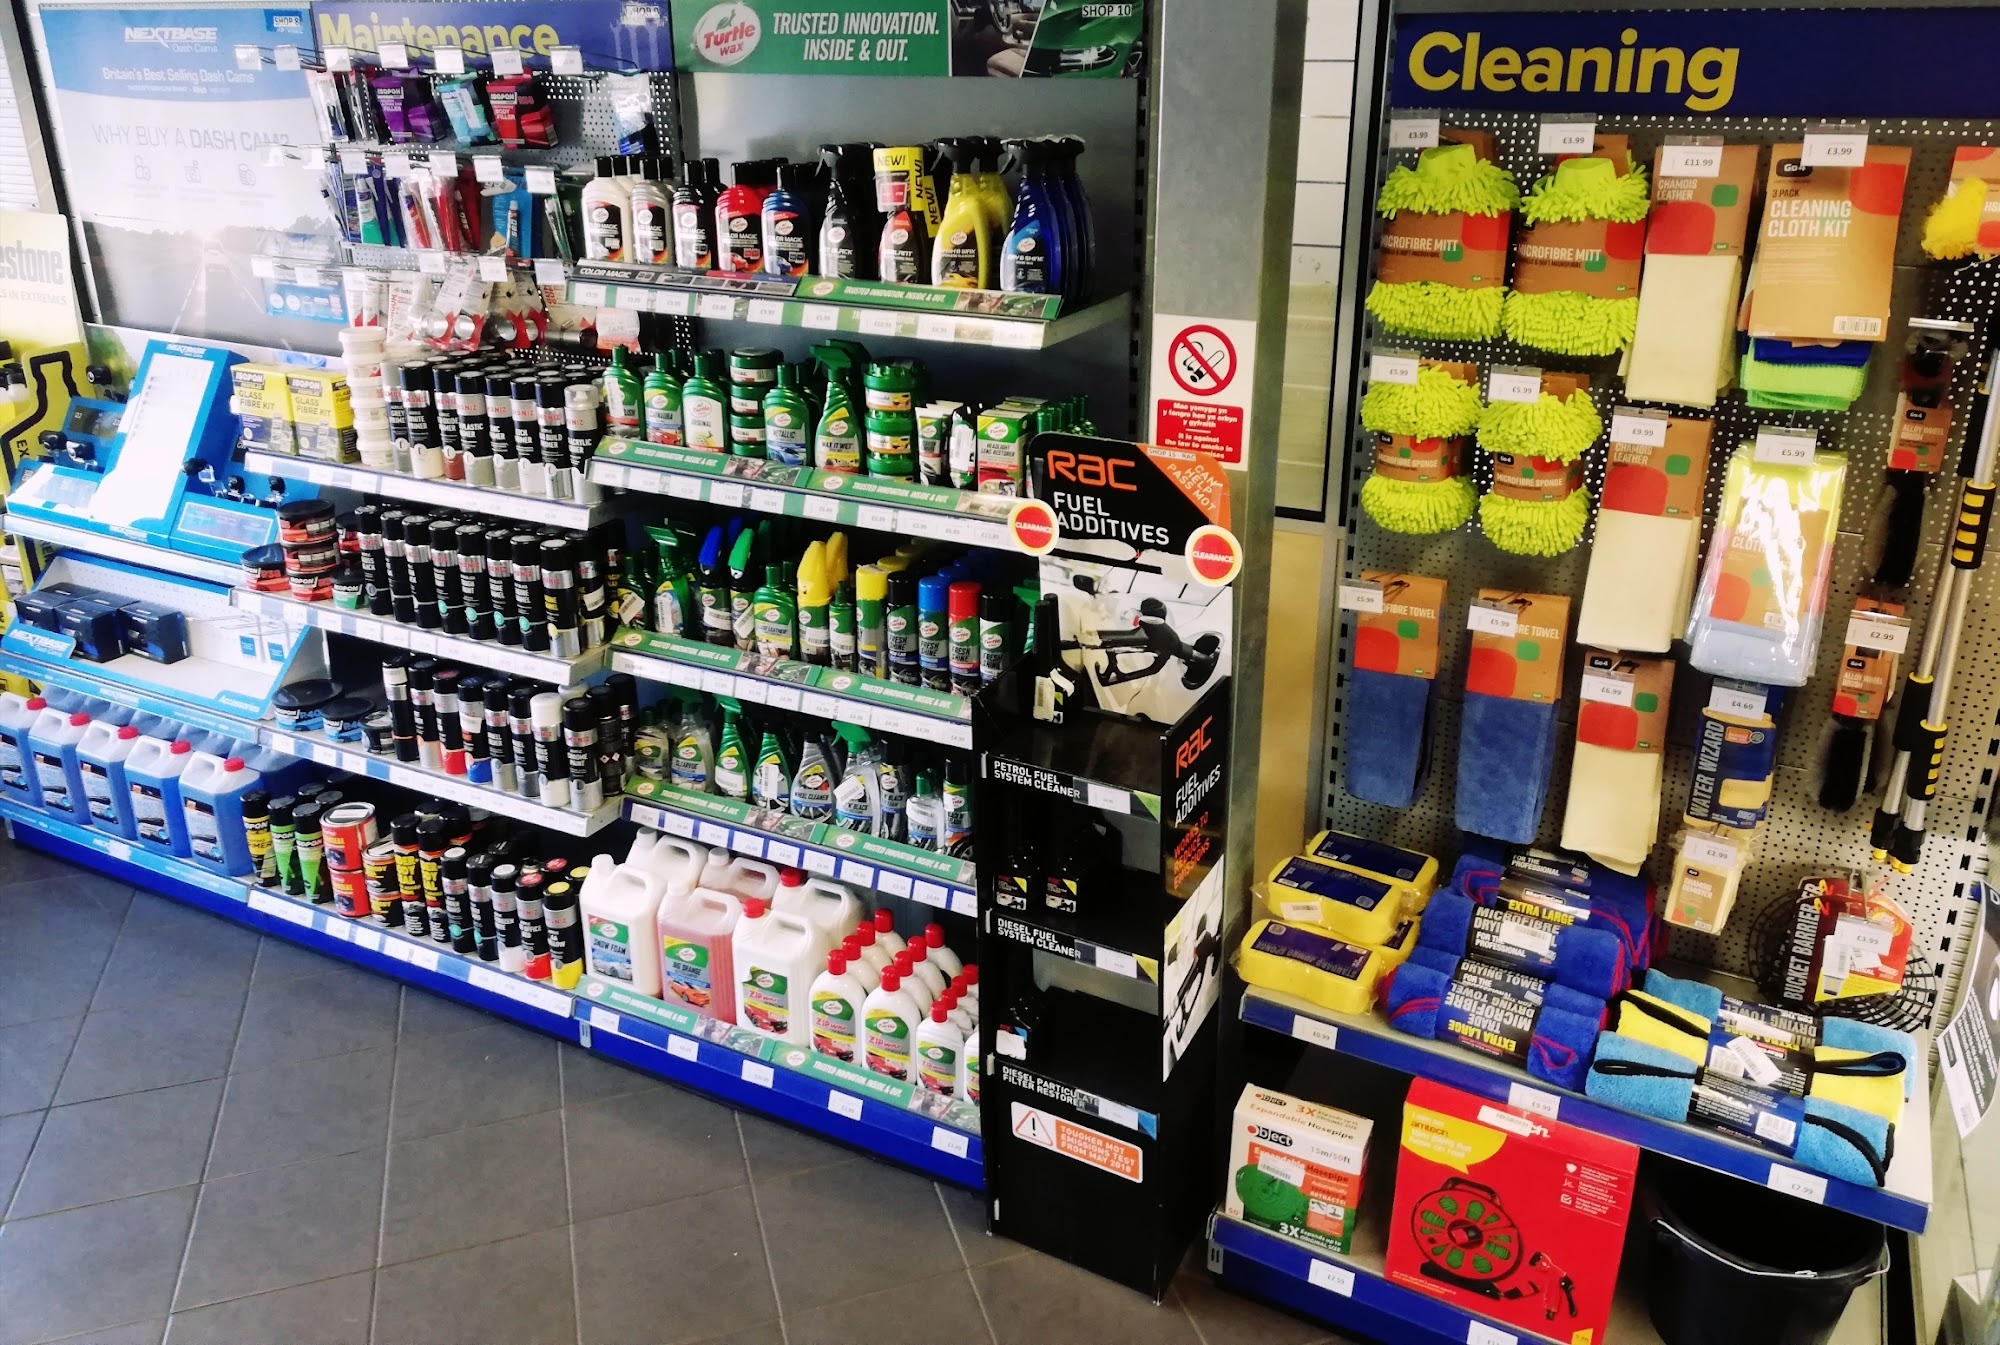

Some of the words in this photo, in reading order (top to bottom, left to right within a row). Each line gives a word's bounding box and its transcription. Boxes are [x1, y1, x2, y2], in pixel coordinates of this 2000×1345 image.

[1082, 5, 1117, 17] SHOP
[1119, 5, 1132, 17] 10
[772, 12, 840, 35] TRUSTED
[843, 12, 940, 36] INNOVATION.
[125, 27, 217, 47] NEXTBASE
[319, 13, 560, 58] Maintenance
[704, 22, 756, 49] Turtle
[720, 42, 744, 56] wax
[803, 38, 855, 61] INSIDE
[859, 39, 871, 61] &
[874, 39, 909, 62] OUT.
[102, 67, 142, 81] Britain's
[144, 68, 165, 80] Best
[168, 69, 199, 84] Selling
[200, 69, 224, 82] Dash
[226, 70, 255, 83] Cams
[1408, 28, 1740, 111] Cleaning
[92, 125, 131, 145] WHY
[136, 126, 169, 146] BUY
[175, 128, 187, 147] A
[189, 129, 235, 150] DASH
[1408, 131, 1428, 139] £3.99
[1562, 136, 1585, 144] £3.99
[877, 155, 906, 166] NEW!
[1827, 147, 1852, 155] £3.99
[1684, 158, 1714, 167] £11.99
[1658, 178, 1698, 190] CHAMOIS
[1772, 189, 1778, 198] 3
[1779, 189, 1800, 198] PACK
[1657, 190, 1694, 201] LEATHER
[1770, 200, 1852, 219] CLEANING
[1768, 219, 1822, 238] CLOTH
[1824, 220, 1852, 238] KIT
[1434, 239, 1459, 251] MITT
[1519, 243, 1574, 261] MICROFIBRE
[1575, 249, 1602, 262] MITT
[580, 267, 605, 277] COLOR
[605, 270, 632, 279] MAGIC
[235, 372, 264, 384] ISOPON
[1389, 368, 1409, 376] £5.99
[292, 378, 321, 390] ISOPON
[1512, 386, 1532, 394] £5.99
[238, 391, 263, 401] GLASS
[240, 400, 262, 410] FIBRE
[263, 402, 275, 411] KIT
[295, 396, 319, 407] GLASS
[297, 405, 319, 415] FIBRE
[320, 408, 331, 417] KIT
[1632, 428, 1654, 437] £9.99
[1614, 443, 1653, 455] CHAMOIS
[1781, 449, 1805, 458] £5.99
[1613, 453, 1649, 465] LEATHER
[1167, 463, 1194, 494] PASS
[1193, 487, 1217, 512] MOT
[1185, 467, 1214, 494] HELP
[1054, 491, 1110, 517] FUEL
[1015, 521, 1054, 535] CLEARANCE
[1057, 511, 1170, 546] ADDITIVES
[1192, 549, 1234, 564] CLEARANCE
[1490, 619, 1510, 627] £5.99
[1531, 625, 1560, 640] TOWEL
[1870, 631, 1894, 641] £2.99
[1601, 687, 1622, 696] £6.99
[1731, 701, 1753, 710] £4.69
[1698, 720, 1725, 774] WIZARD
[994, 761, 1032, 777] PETROL
[1034, 771, 1060, 785] FUEL
[994, 770, 1032, 787] SYSTEM
[1034, 779, 1081, 799] CLEANER
[1175, 772, 1200, 809] FUEL
[1174, 764, 1221, 829] ADDITIVES
[1690, 776, 1715, 818] WATER
[1174, 821, 1200, 858] WORKS
[1200, 811, 1209, 829] TO
[1174, 835, 1201, 876] REDUCE
[1174, 838, 1211, 891] EMISSIONS
[1706, 850, 1728, 860] £2.99
[1511, 860, 1561, 876] PROFESSIONAL
[1476, 906, 1561, 935] MICROFIBRE
[1508, 898, 1540, 917] EXTRA
[1542, 909, 1575, 926] LARGE
[998, 918, 1031, 935] DIESEL
[1033, 929, 1059, 944] FUEL
[1476, 931, 1491, 941] FOR
[1792, 902, 1821, 956] BARRIER
[593, 938, 610, 952] SNOW
[610, 943, 627, 956] FOAM
[997, 927, 1034, 946] SYSTEM
[1036, 936, 1082, 960] CLEANER
[1475, 939, 1527, 958] PROFESSIONAL
[1460, 961, 1503, 981] DRYING
[1505, 973, 1546, 993] TOWEL
[1463, 973, 1478, 984] FOR
[1479, 976, 1493, 988] THE
[1784, 957, 1810, 1000] BUCKET
[1451, 982, 1489, 1002] TOWEL
[1444, 991, 1533, 1032] MICROFIBRE
[1491, 996, 1536, 1019] DRYING
[1448, 1019, 1482, 1040] LARGE
[1467, 1013, 1501, 1034] TRADE
[1770, 1013, 1818, 1038] DRYING
[1483, 1029, 1517, 1053] EXTRA
[1002, 1065, 1035, 1084] DIESEL
[1002, 1074, 1035, 1091] FILTER
[1036, 1083, 1085, 1109] RESTORER
[1296, 1105, 1317, 1117] 3X
[1250, 1104, 1306, 1125] Expandable
[1308, 1121, 1354, 1140] Hosepipe
[1410, 1120, 1449, 1137] amtech
[1060, 1125, 1106, 1148] TOUGHER
[1108, 1141, 1125, 1155] MOT
[1061, 1133, 1112, 1158] EMISSIONS
[1113, 1152, 1135, 1167] TEST
[1061, 1141, 1086, 1159] FROM
[1088, 1150, 1108, 1165] MAY
[1110, 1158, 1132, 1173] 2018
[1306, 1164, 1349, 1183] Hosepipe
